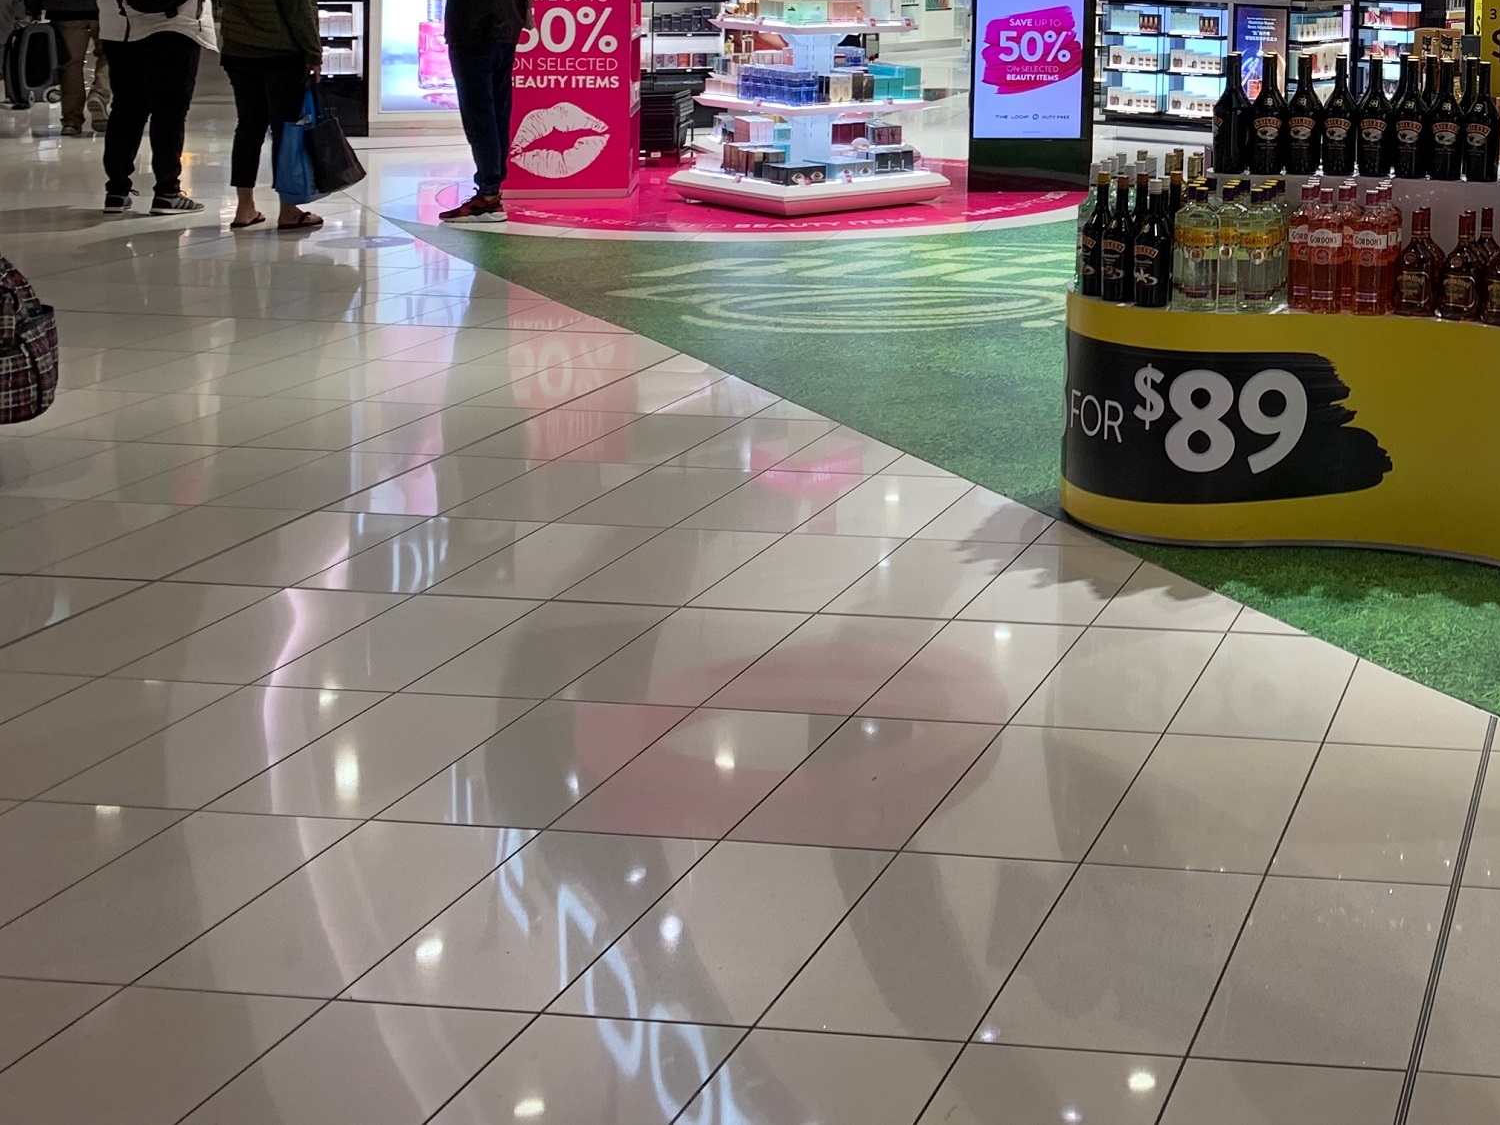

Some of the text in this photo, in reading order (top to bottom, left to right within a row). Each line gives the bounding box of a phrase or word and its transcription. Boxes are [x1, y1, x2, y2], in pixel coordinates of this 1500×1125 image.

[1490, 9, 1498, 20] 3
[1009, 18, 1061, 27] SAVE UP TO
[1068, 362, 1309, 475] FOR $89
